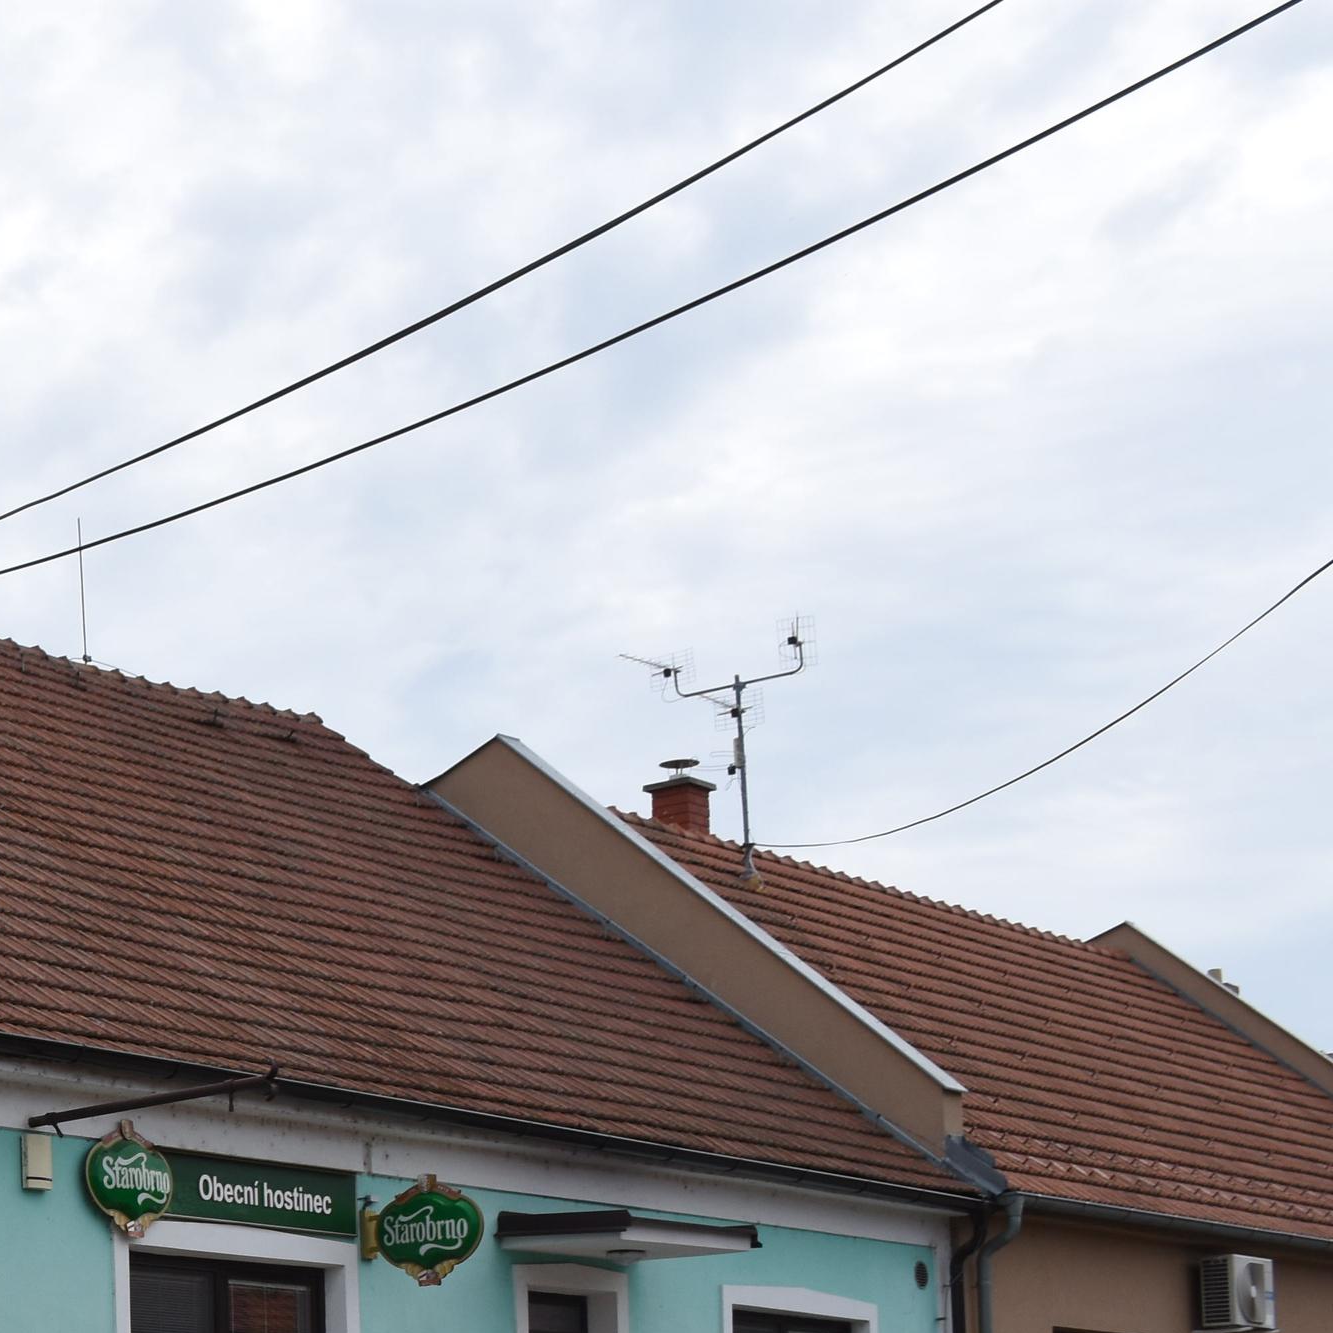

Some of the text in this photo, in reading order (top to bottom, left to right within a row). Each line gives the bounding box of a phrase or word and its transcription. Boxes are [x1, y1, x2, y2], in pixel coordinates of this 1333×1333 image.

[102, 1152, 170, 1206] Starobrno
[199, 1174, 332, 1215] Obecní hostinec
[383, 1205, 469, 1256] Starobrno
